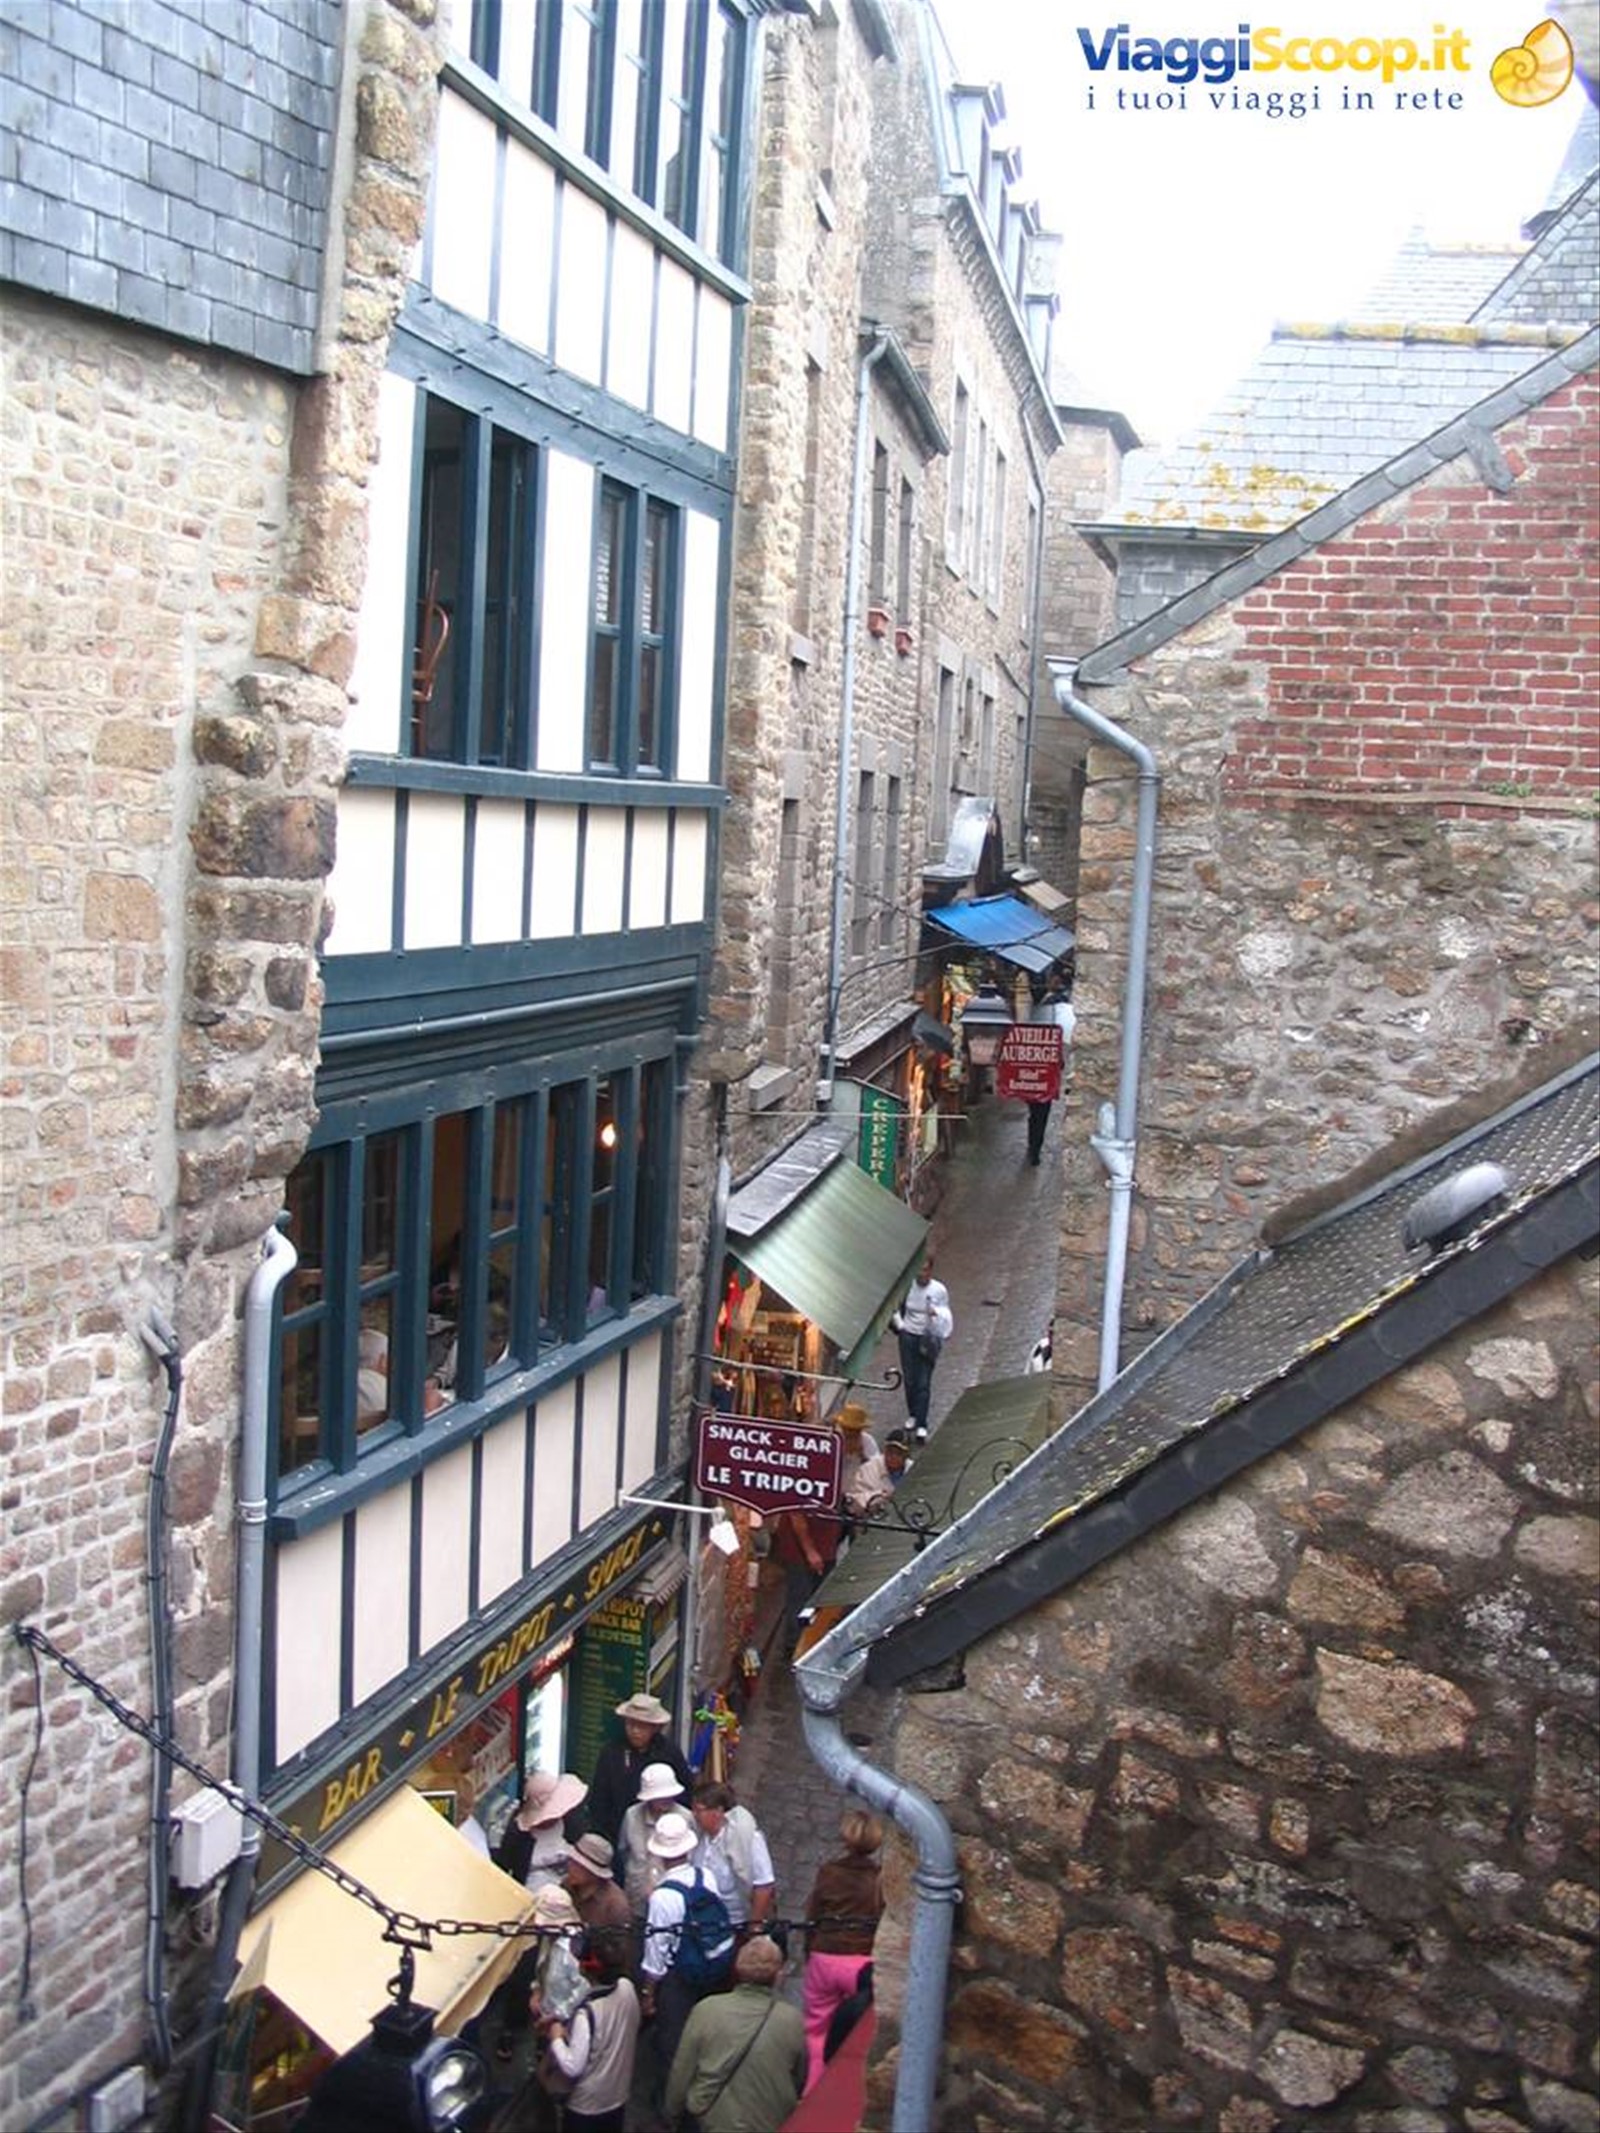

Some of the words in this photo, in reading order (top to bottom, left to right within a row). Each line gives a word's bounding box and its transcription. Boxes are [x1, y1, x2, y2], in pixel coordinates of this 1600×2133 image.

[1001, 1046, 1059, 1062] AUBERGE
[708, 1424, 772, 1446] SNACK
[793, 1436, 832, 1454] BAR
[729, 1446, 809, 1469] GLACIER
[707, 1466, 731, 1485] LE
[740, 1470, 829, 1498] TRIPOT
[319, 1747, 381, 1830] BAR
[426, 1676, 463, 1738] LE
[477, 1602, 556, 1695] TRIPOT
[584, 1525, 648, 1600] SNACK
